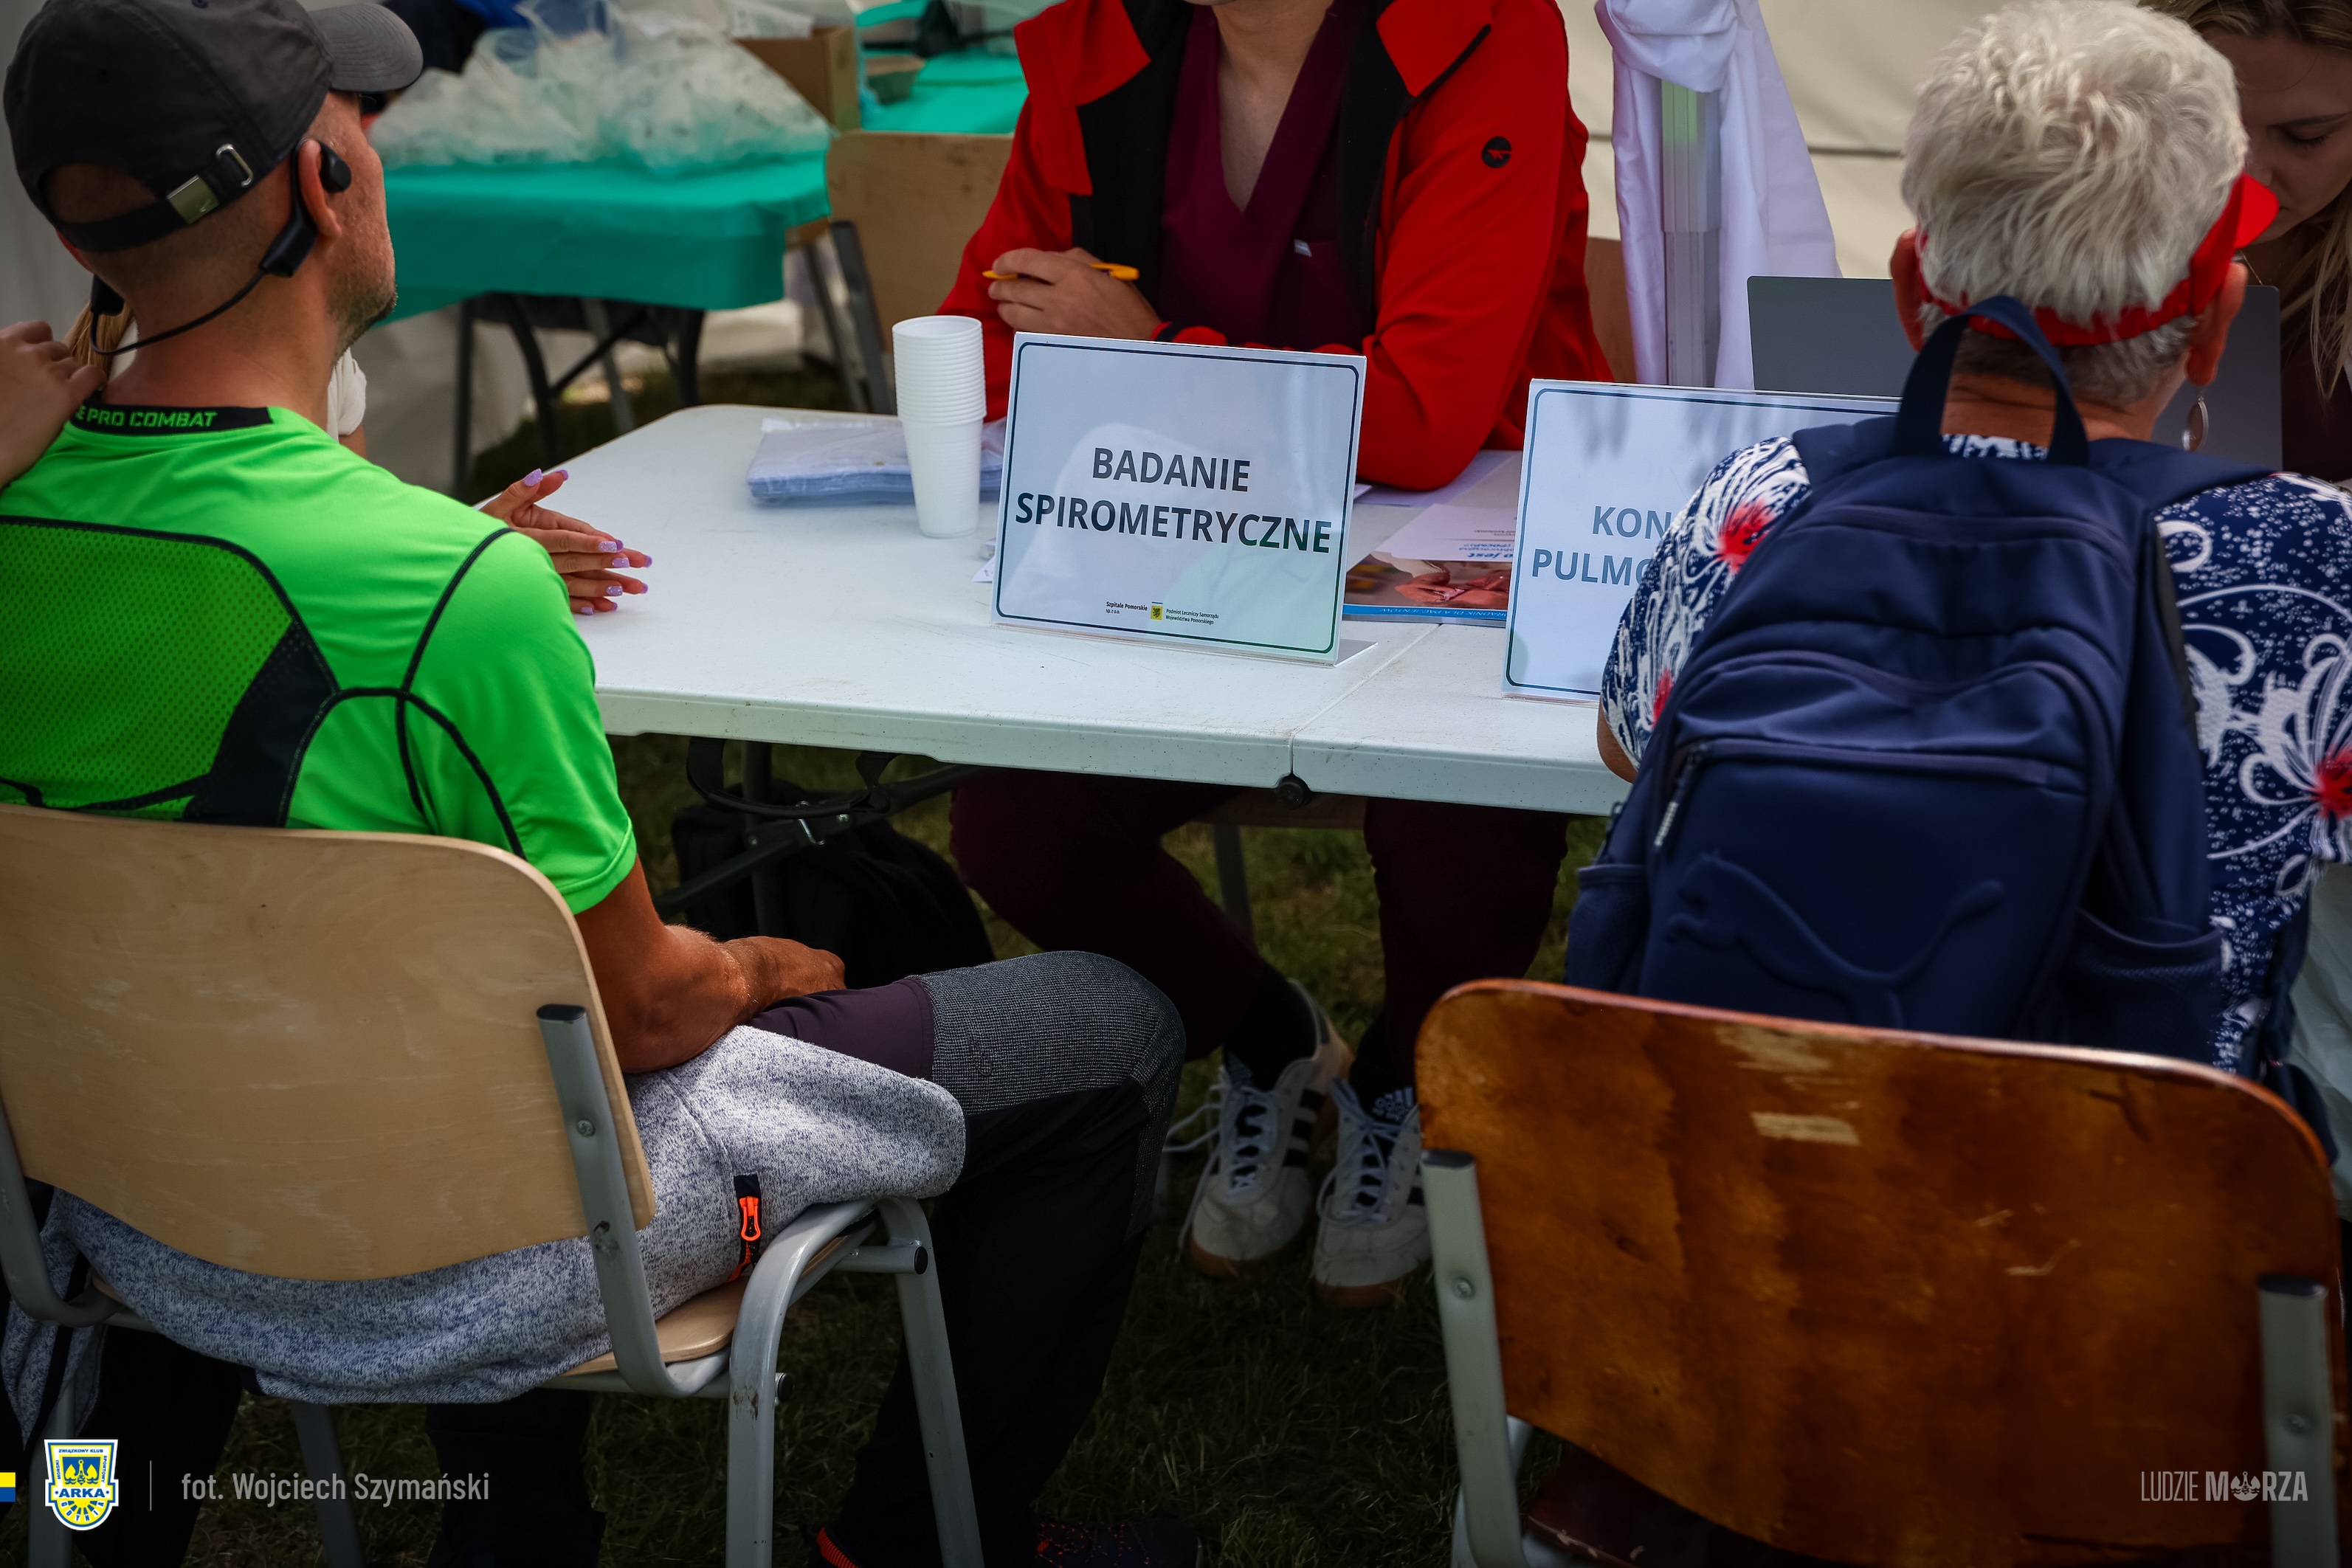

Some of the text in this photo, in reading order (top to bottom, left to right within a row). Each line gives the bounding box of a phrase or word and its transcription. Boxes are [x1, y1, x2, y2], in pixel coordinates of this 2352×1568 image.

[87, 408, 125, 426] PRO
[129, 411, 217, 428] COMBAT
[1092, 447, 1251, 492] BADANIE
[1015, 492, 1332, 553] SPIROMETRYCZNE
